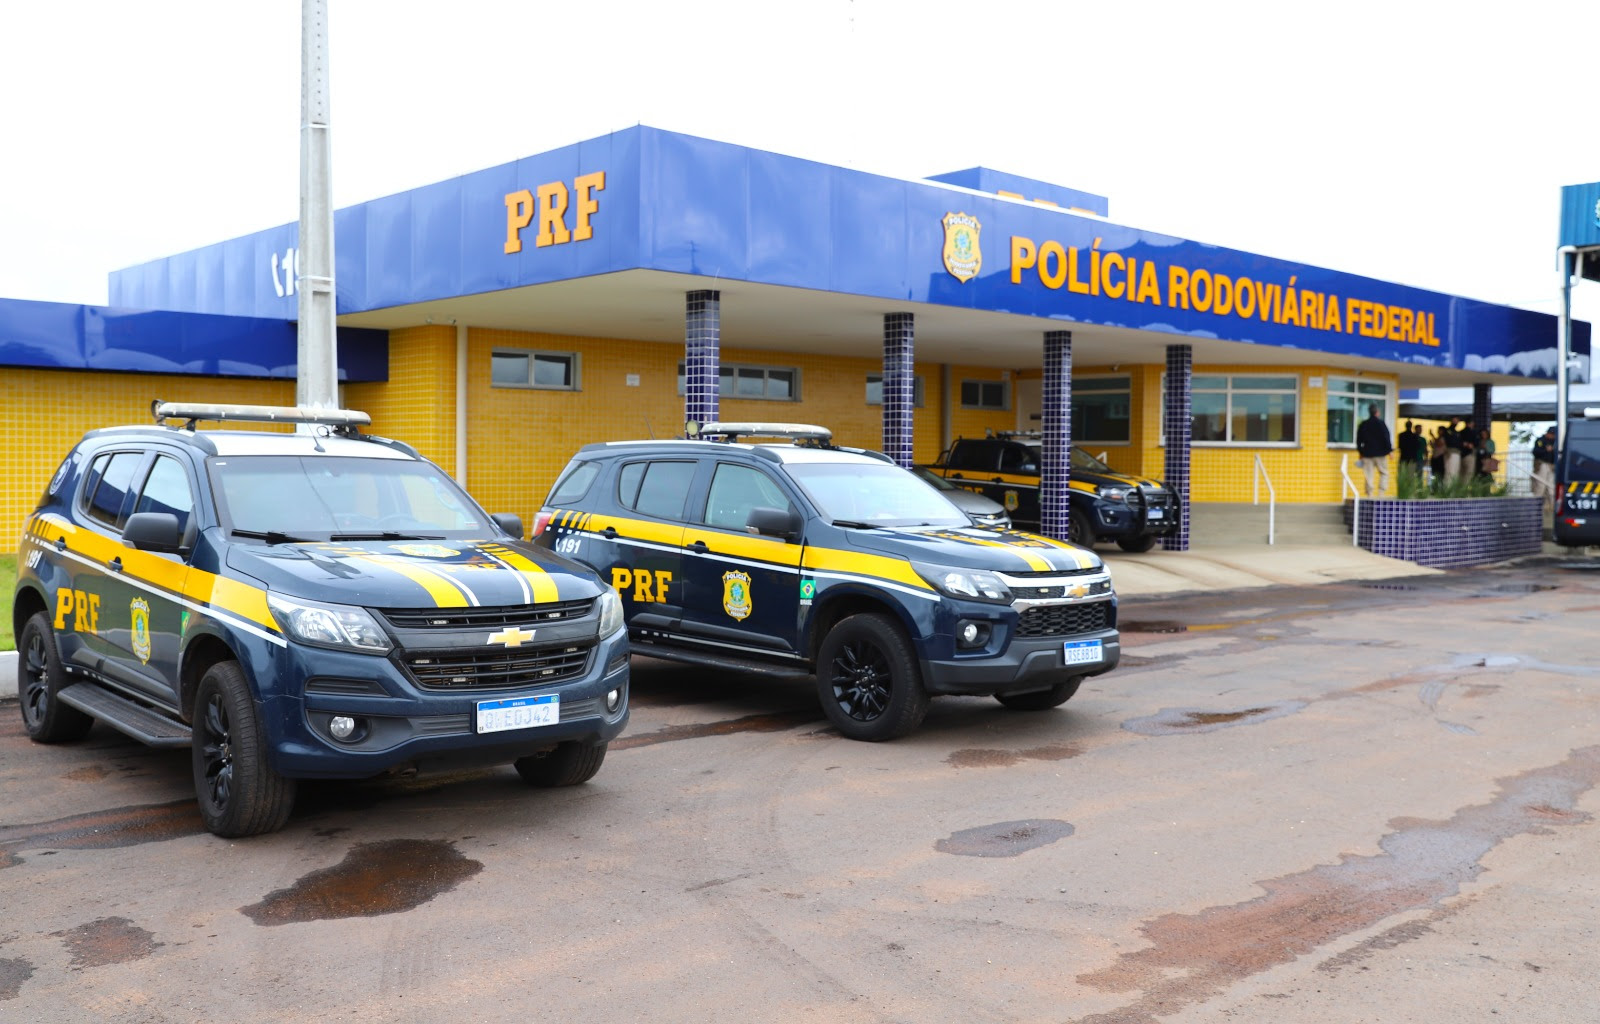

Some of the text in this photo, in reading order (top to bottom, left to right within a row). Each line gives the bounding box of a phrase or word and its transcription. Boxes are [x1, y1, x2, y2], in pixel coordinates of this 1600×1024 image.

[504, 171, 605, 254] PRF
[1010, 236, 1441, 347] POLÍCIA RODOVIÁRIA FEDERAL
[1576, 500, 1597, 510] 191
[561, 538, 581, 554] 191
[611, 567, 672, 604] PRF
[54, 587, 100, 635] PRF
